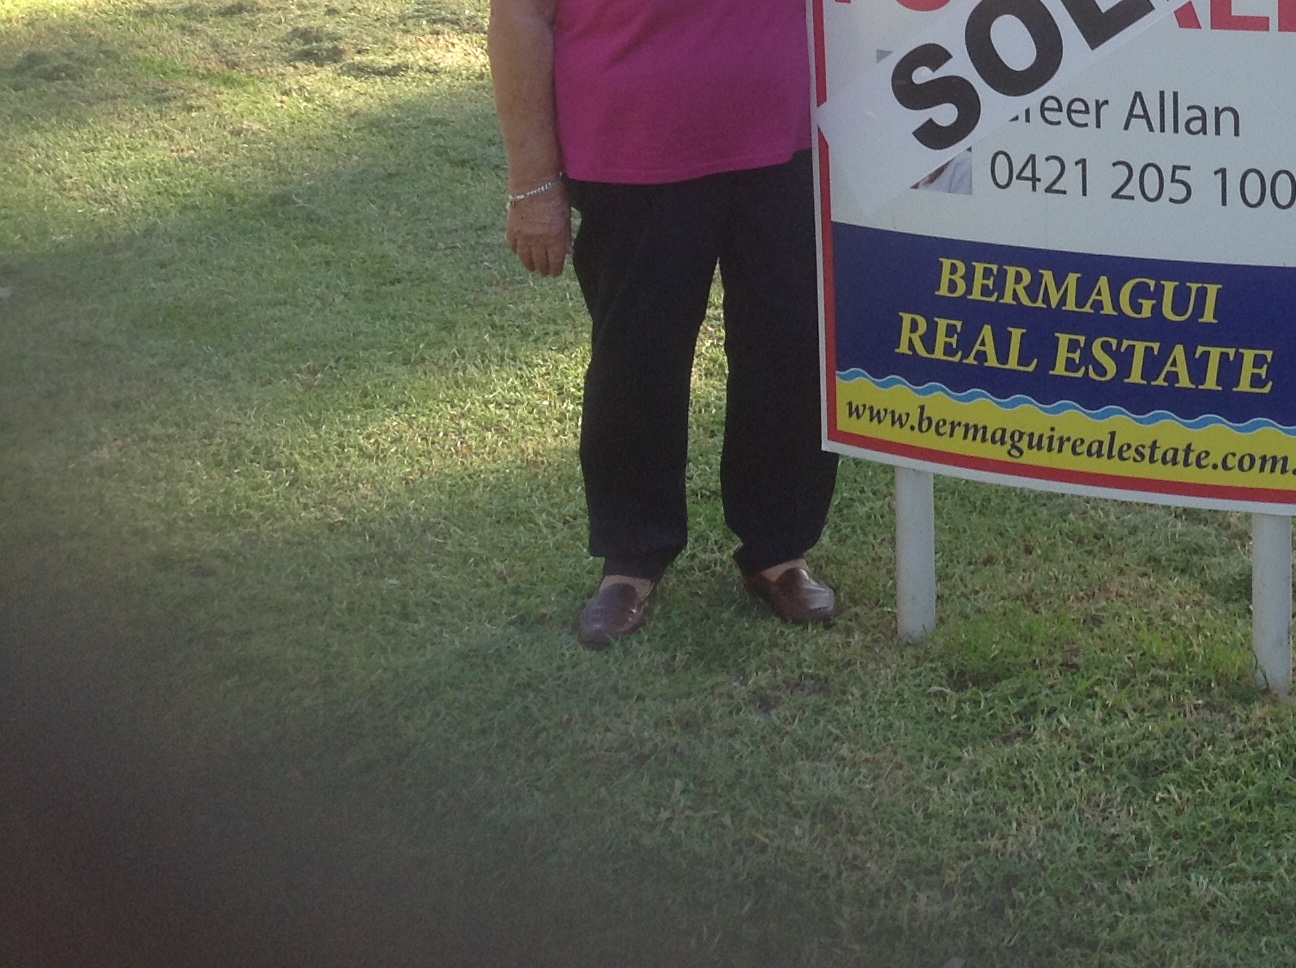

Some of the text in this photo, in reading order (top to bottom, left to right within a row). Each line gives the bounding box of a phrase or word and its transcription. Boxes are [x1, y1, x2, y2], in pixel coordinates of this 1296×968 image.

[1122, 90, 1240, 137] Allan
[990, 150, 1088, 197] 0421
[1111, 160, 1193, 205] 205
[934, 258, 1223, 324] BERMAGUI
[895, 312, 1275, 395] REAL ESTATE
